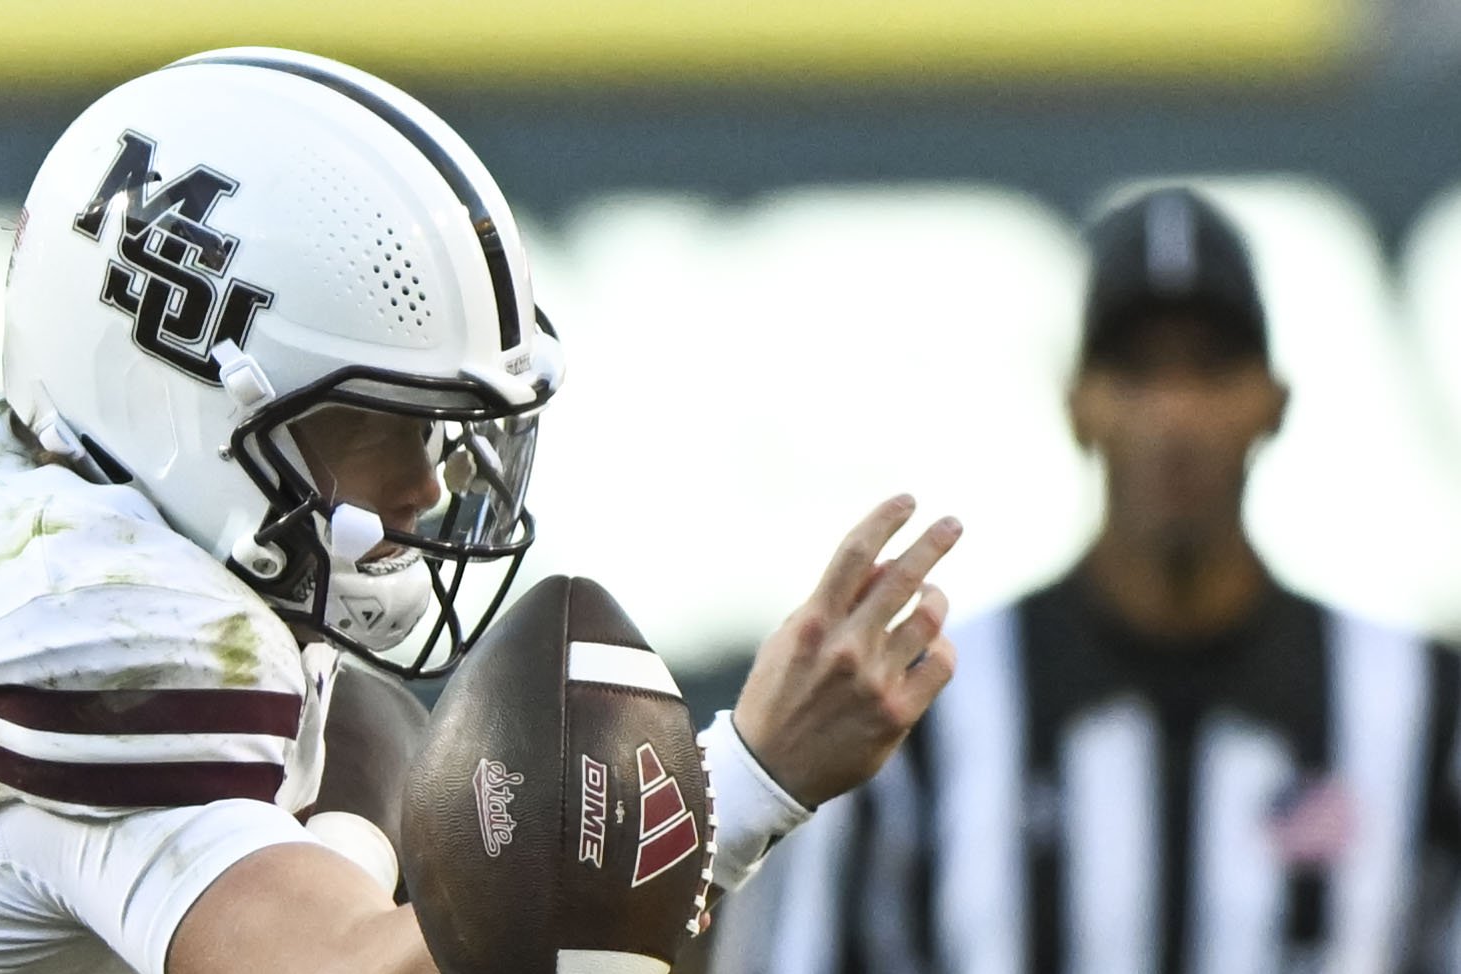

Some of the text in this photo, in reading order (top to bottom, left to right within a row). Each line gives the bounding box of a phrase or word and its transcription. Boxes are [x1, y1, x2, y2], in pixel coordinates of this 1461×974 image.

[72, 128, 275, 387] MSU
[473, 759, 524, 857] State
[579, 753, 607, 868] DIME
